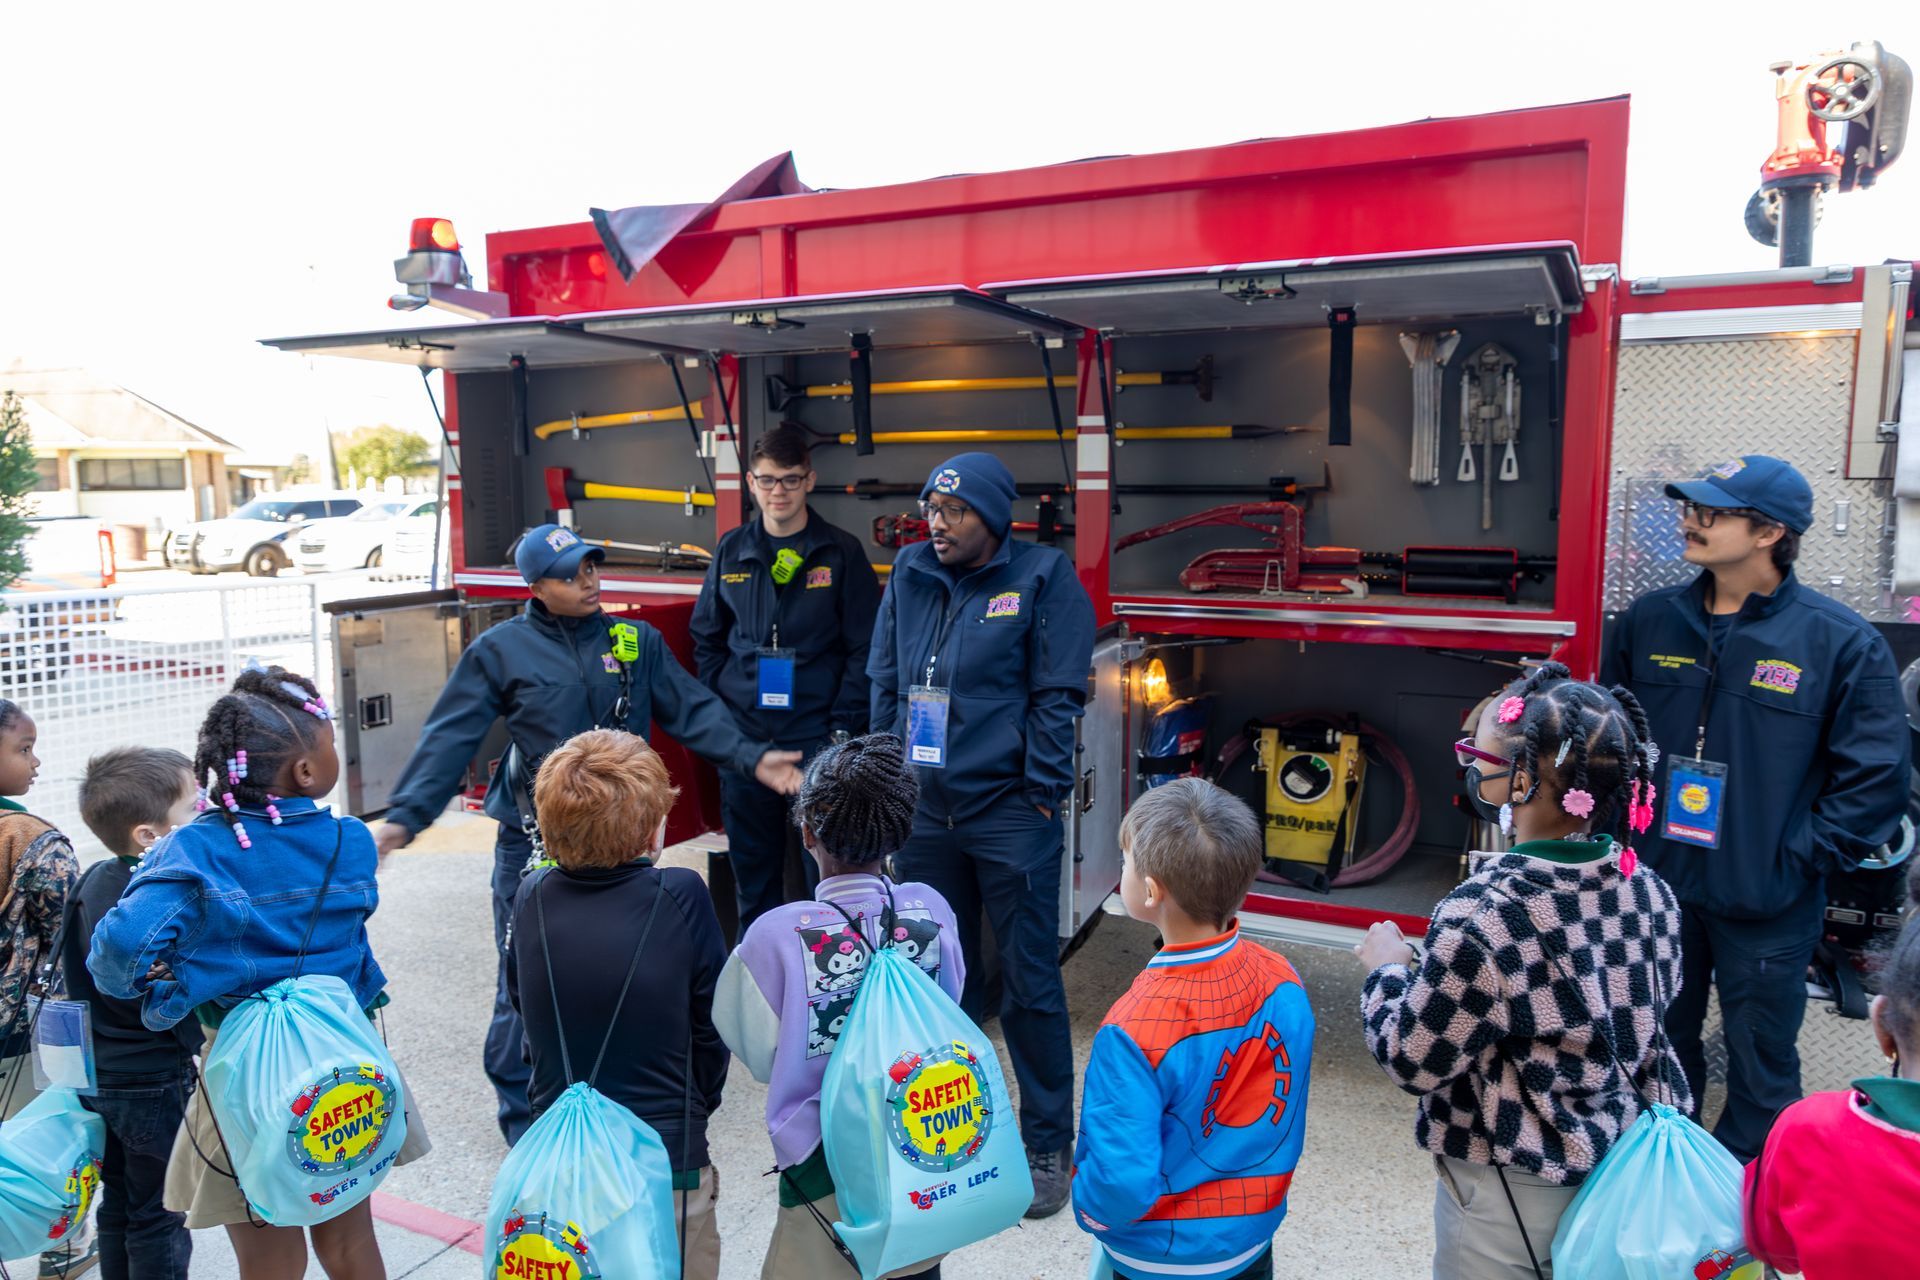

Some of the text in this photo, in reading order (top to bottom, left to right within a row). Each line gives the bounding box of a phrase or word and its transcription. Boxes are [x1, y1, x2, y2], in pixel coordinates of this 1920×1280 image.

[987, 596, 1021, 614] FIRE
[1751, 664, 1801, 690] FIRE
[909, 1073, 971, 1114] SAFETY
[310, 1090, 375, 1136] SAFETY
[920, 1101, 973, 1138] TOWN
[320, 1112, 374, 1151] TOWN
[369, 1150, 397, 1176] LEPC
[320, 1178, 358, 1203] CAER
[968, 1167, 999, 1188] LEPC
[919, 1183, 957, 1206] CAER
[504, 1251, 571, 1280] SAFETY
